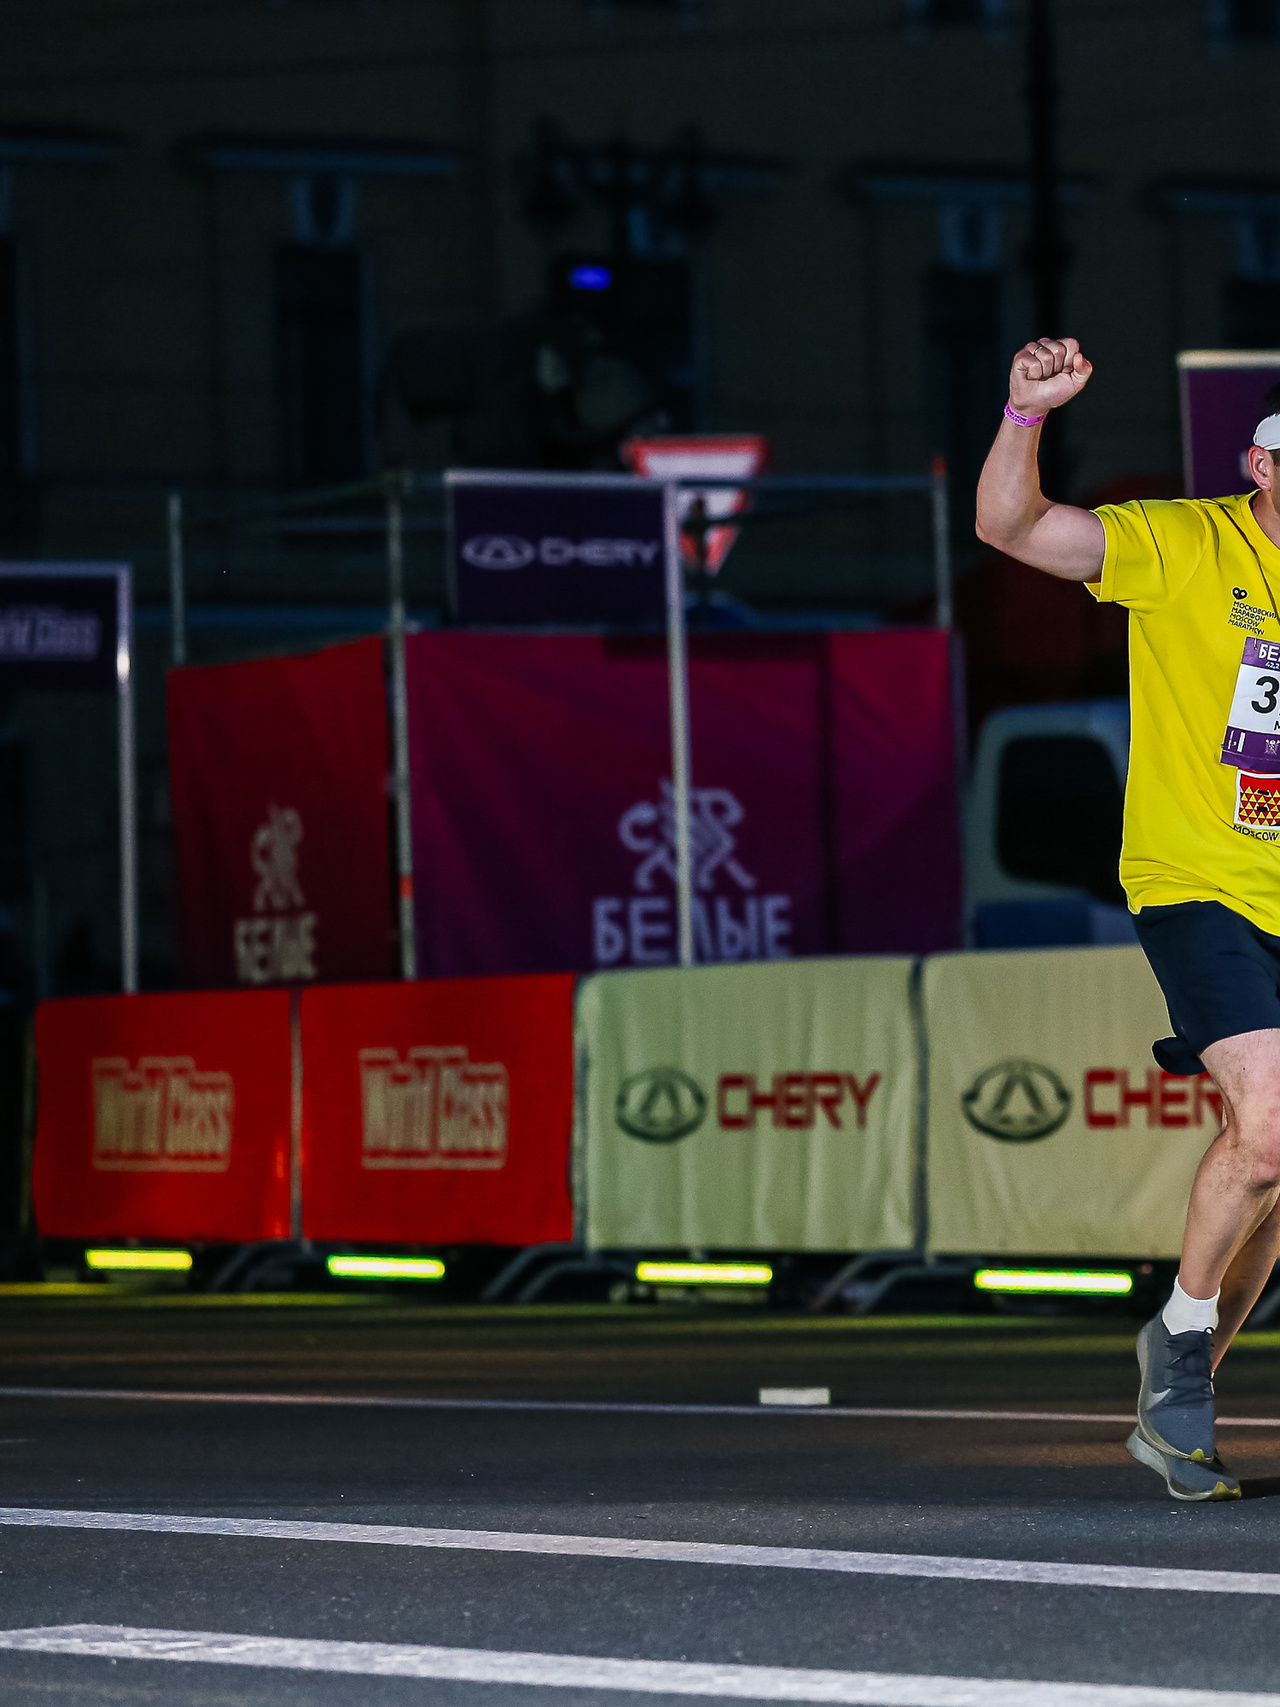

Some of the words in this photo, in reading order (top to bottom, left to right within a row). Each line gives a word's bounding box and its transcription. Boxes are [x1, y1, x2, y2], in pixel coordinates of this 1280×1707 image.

[1230, 612, 1260, 627] MOSCOW
[1233, 824, 1279, 841] MOSCOW
[717, 1071, 882, 1129] CHERY
[1084, 1068, 1223, 1128] CHER
